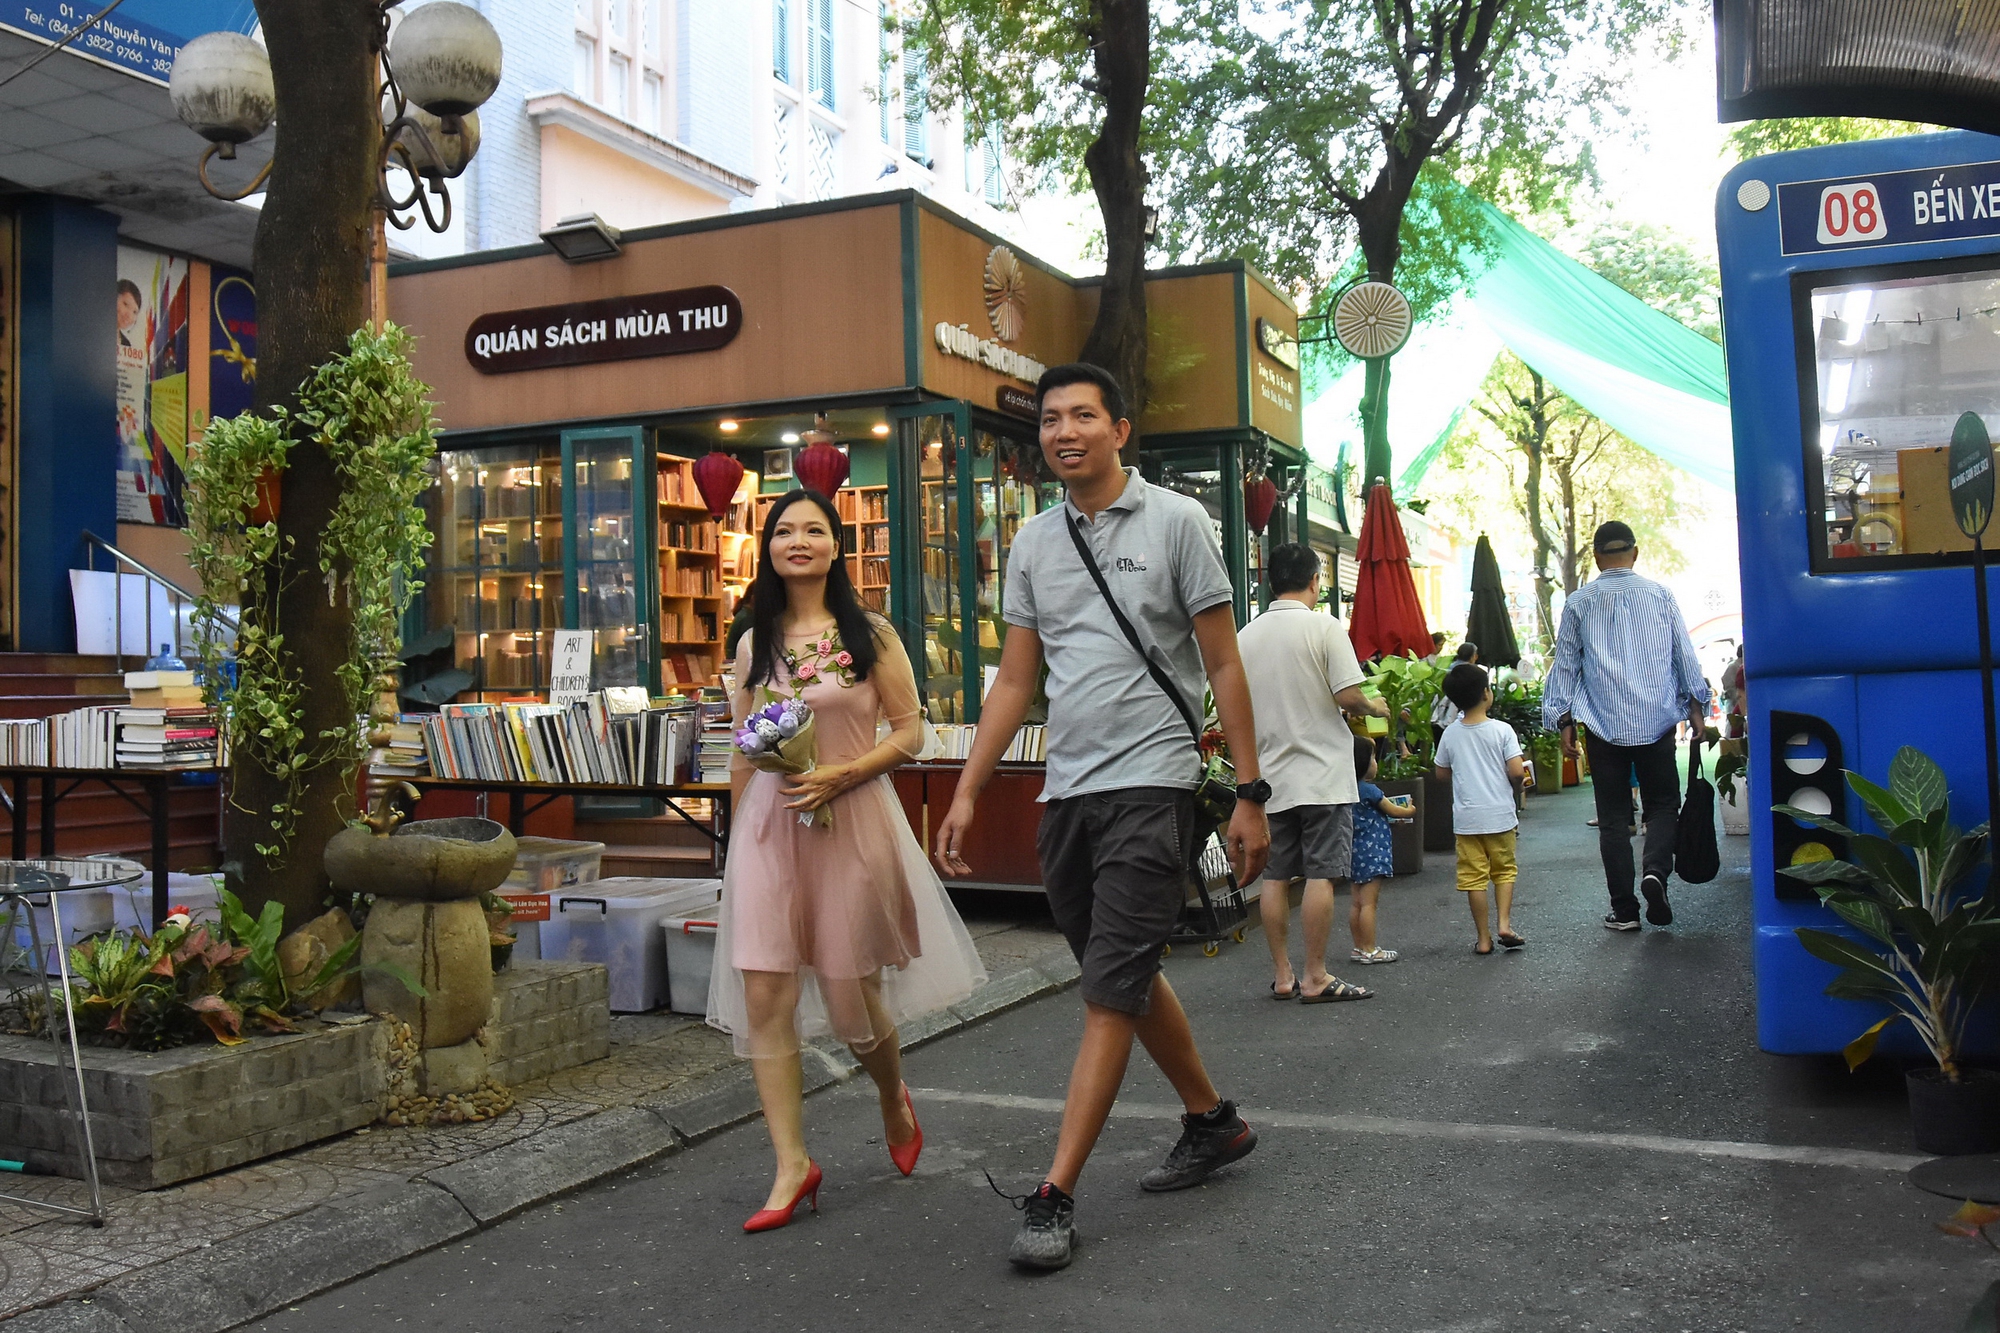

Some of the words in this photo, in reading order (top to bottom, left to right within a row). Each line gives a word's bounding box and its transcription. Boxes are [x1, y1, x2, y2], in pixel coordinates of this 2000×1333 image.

[24, 7, 45, 27] Tel:
[85, 34, 114, 53] 3822
[116, 46, 143, 64] 9766
[151, 58, 172, 74] 382
[60, 3, 74, 19] 01
[104, 19, 147, 47] Nguyễn
[150, 37, 172, 56] Văn
[1824, 189, 1878, 237] 08
[1913, 173, 1964, 226] BẾN
[1971, 183, 2000, 220] XE
[474, 325, 537, 359] QUÁN
[544, 318, 607, 348] SÁCH
[615, 309, 671, 339] MÙA
[678, 304, 728, 332] THU
[934, 321, 980, 362] QUÁN
[978, 337, 1018, 377] SÁCH
[563, 637, 583, 653] ART
[565, 656, 573, 670] &
